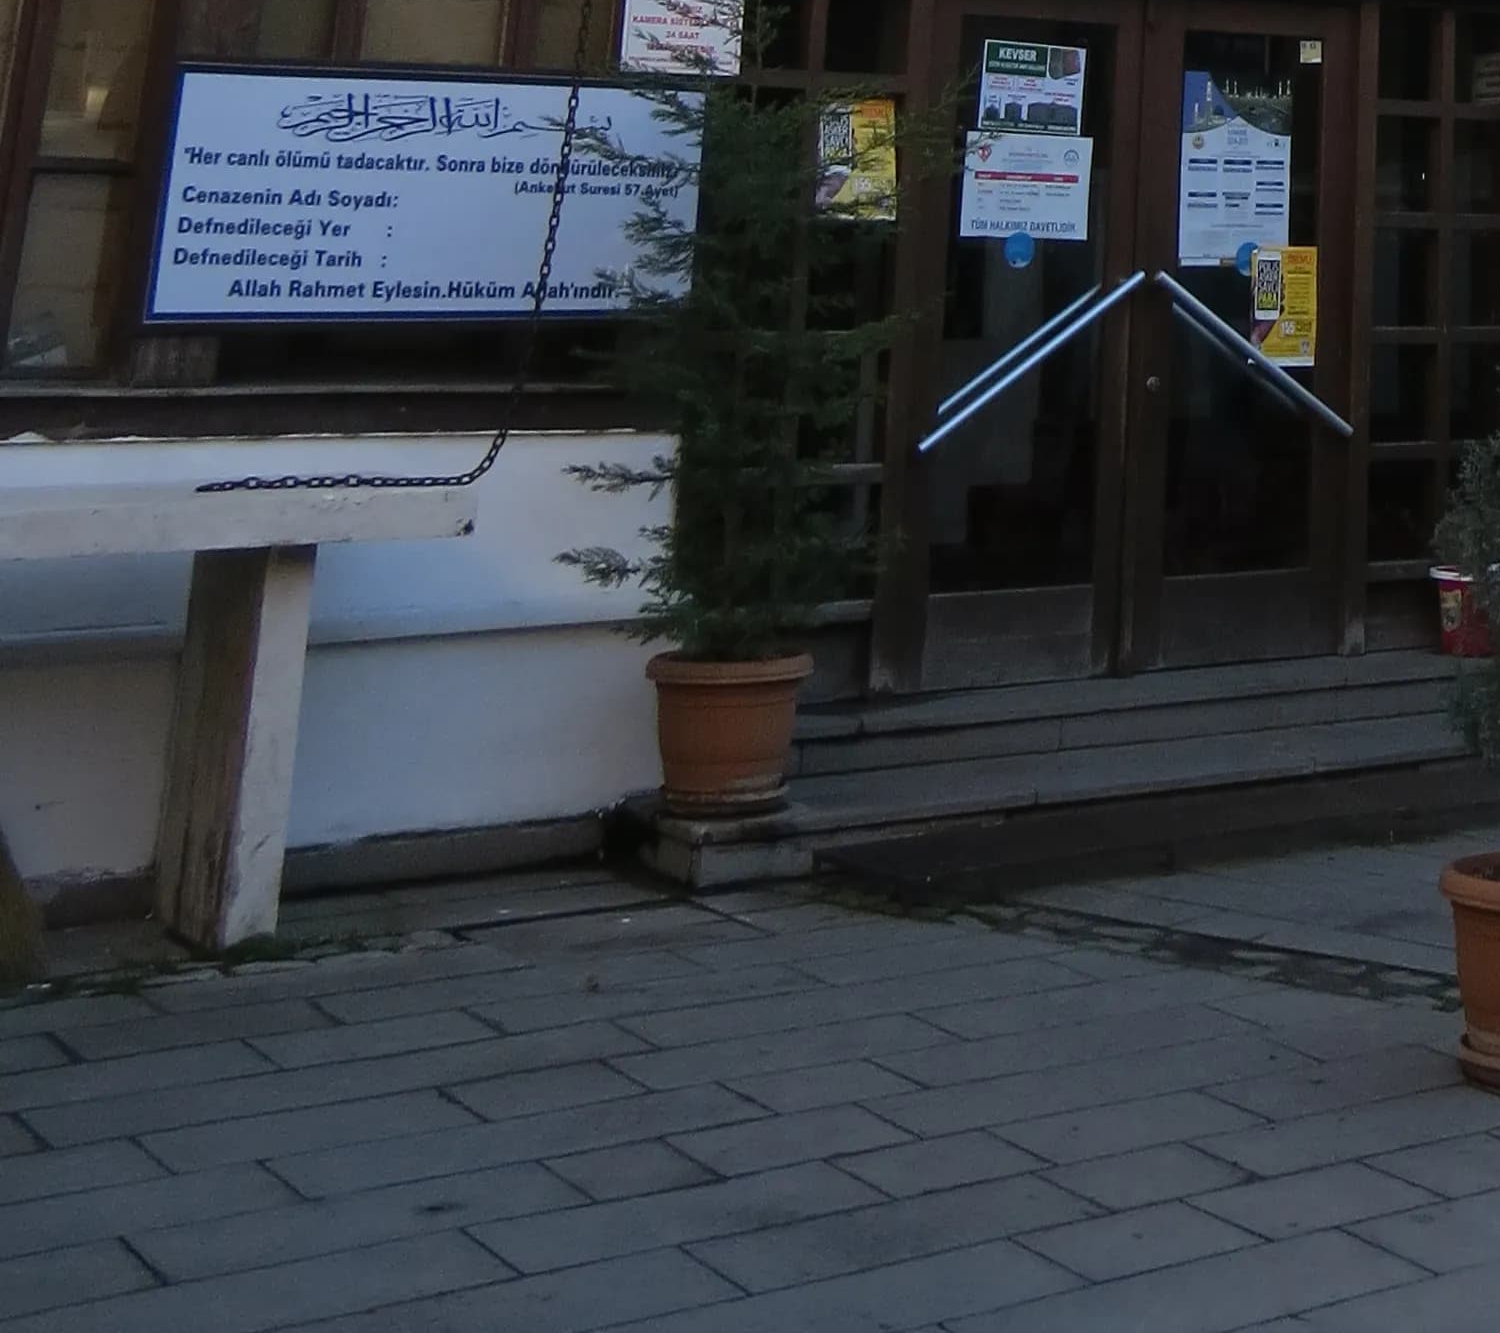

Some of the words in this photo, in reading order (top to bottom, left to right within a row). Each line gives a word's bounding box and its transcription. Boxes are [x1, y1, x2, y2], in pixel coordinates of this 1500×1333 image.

[999, 47, 1038, 62] KEVSER
[227, 149, 270, 167] canlı
[275, 150, 331, 169] ölümü
[336, 152, 430, 172] tadacaktır.
[436, 154, 486, 173] Sonra
[491, 156, 524, 175] bize
[182, 185, 283, 206] Cenazenin
[288, 188, 322, 206] Adı
[328, 190, 399, 211] Soyadı:
[580, 181, 621, 197] Suresi
[177, 215, 312, 240] Defnedileceği
[319, 220, 352, 237] Yer
[173, 247, 308, 270] Defnedileceği
[314, 250, 363, 268] Tarih
[227, 279, 282, 298] Allah
[287, 280, 365, 299] Rahmet
